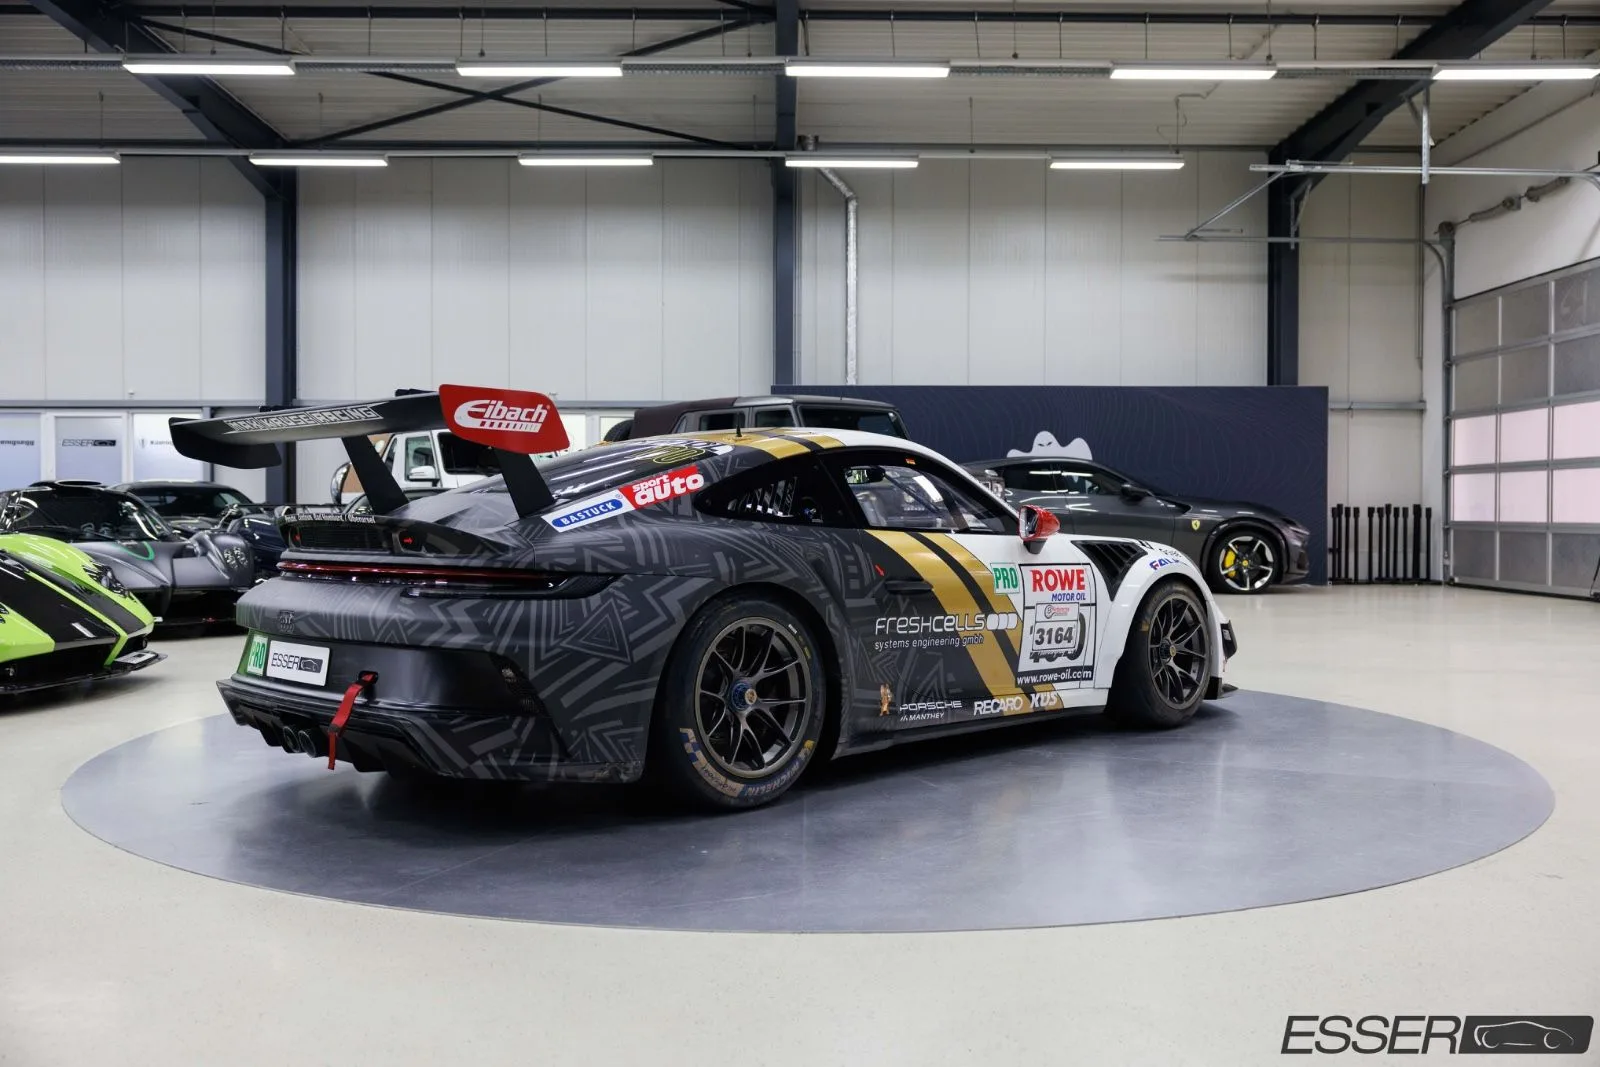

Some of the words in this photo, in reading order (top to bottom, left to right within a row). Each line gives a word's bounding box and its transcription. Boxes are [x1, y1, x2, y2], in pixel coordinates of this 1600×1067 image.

[313, 406, 376, 424] RACING
[454, 400, 547, 432] Eibach
[632, 475, 669, 492] sport
[635, 474, 705, 505] auto
[560, 502, 617, 525] BASTUCK
[993, 567, 1018, 589] PRO
[1031, 569, 1085, 592] ROWE
[1052, 592, 1075, 602] MOTOR
[1076, 592, 1086, 601] OIL
[875, 639, 909, 651] systems
[912, 635, 960, 648] engineering
[962, 633, 984, 646] gmbh
[1035, 627, 1073, 646] 3164
[248, 641, 266, 669] PRO
[271, 652, 300, 671] ESSER
[1017, 668, 1092, 685] www.rowe-oil.com
[900, 700, 963, 711] PORSCHE
[973, 696, 1023, 716] RECARO
[909, 712, 945, 722] MANTHEY
